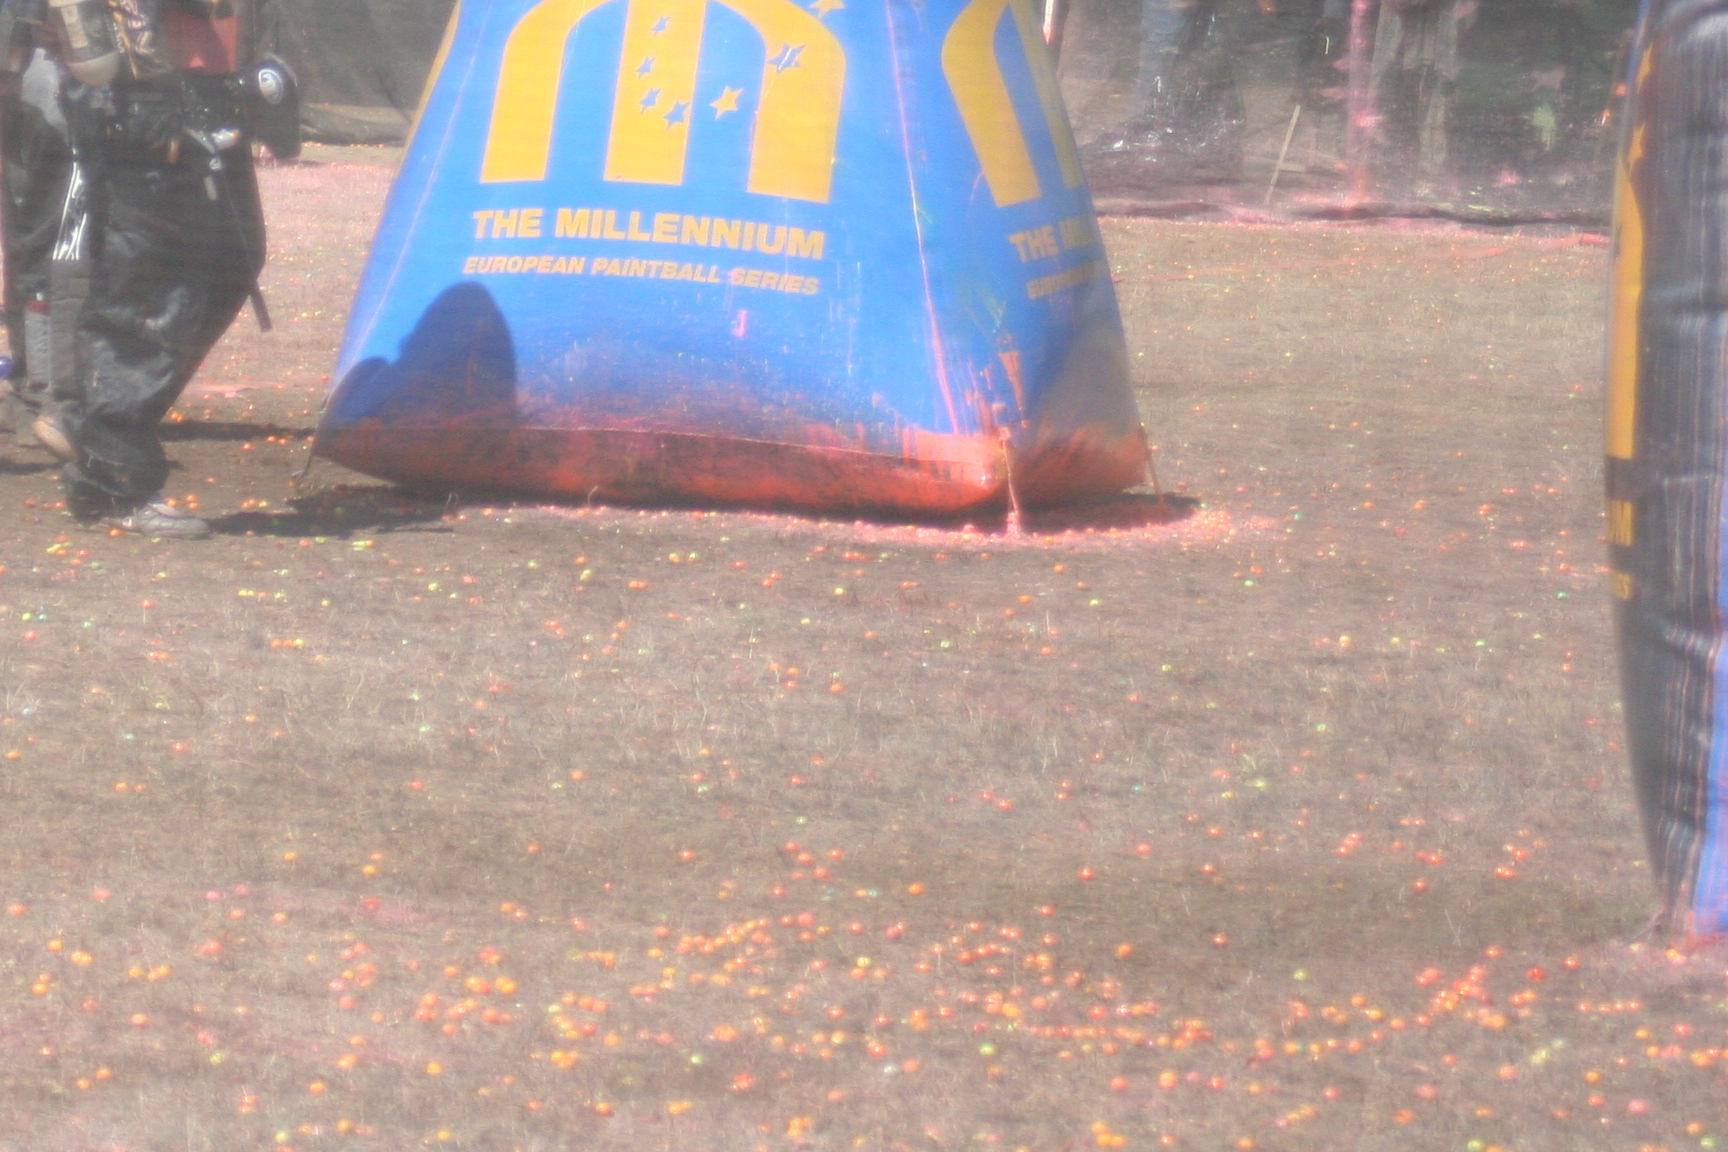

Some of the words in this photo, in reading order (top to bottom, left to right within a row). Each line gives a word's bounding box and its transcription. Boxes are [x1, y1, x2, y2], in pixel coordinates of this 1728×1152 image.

[473, 208, 543, 239] THE
[554, 208, 825, 261] MILLENNIUM
[462, 256, 586, 275] EUROPEAN
[590, 257, 721, 284] PAINTBALL
[728, 267, 820, 296] SERIES
